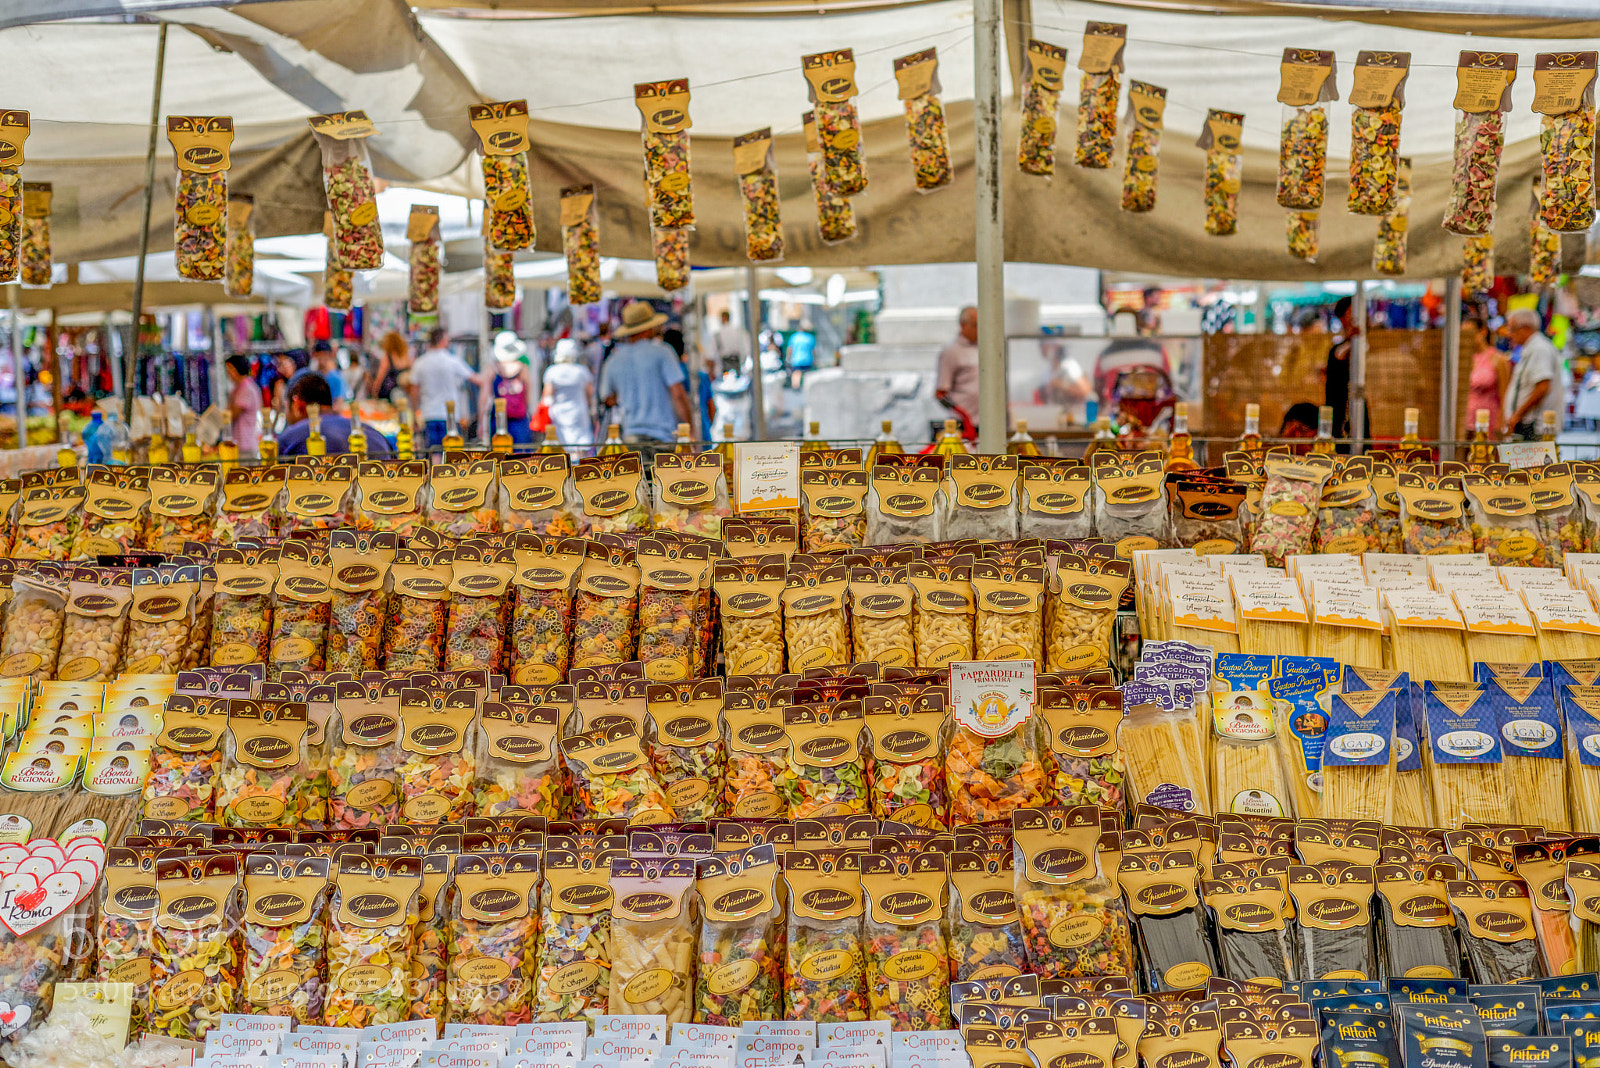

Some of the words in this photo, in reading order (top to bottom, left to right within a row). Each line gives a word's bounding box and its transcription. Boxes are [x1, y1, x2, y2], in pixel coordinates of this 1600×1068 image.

[1512, 445, 1544, 456] Campo
[672, 481, 707, 496] Spizzichino
[960, 670, 1025, 681] PAPPARDELLE
[353, 719, 393, 735] Spizzichino
[417, 727, 456, 744] Spizzichino
[671, 721, 709, 737] Spizzichino
[744, 726, 783, 743] Spizzichino
[1505, 728, 1554, 738] LAGANO
[887, 733, 928, 750] Spizzichino
[1065, 728, 1107, 746] Spizzichino
[1334, 740, 1383, 749] LAGANO
[1441, 738, 1491, 747] LAGANO
[249, 739, 289, 757] Spizzichino
[807, 740, 848, 758] Spizzichino
[10, 775, 60, 785] REGIONALI
[18, 767, 54, 778] Bontà
[92, 775, 139, 786] REGIONALI
[99, 767, 133, 779] Bontà
[1038, 851, 1084, 873] Spizzichino
[475, 890, 520, 909] Spizzichino
[565, 886, 611, 904] Spizzichino
[719, 891, 763, 912] Spizzichino
[806, 890, 853, 910] Spizzichino
[884, 893, 932, 914] Spizzichino
[1142, 885, 1186, 905] Spizzichino
[9, 904, 52, 920] Roma
[172, 895, 218, 917] Spizzichino
[255, 896, 304, 914] Spizzichino
[352, 896, 399, 916] Spizzichino
[626, 894, 672, 914] Spizzichino
[1312, 902, 1358, 920] Spizzichino
[1405, 899, 1449, 917] Spizzichino
[1231, 904, 1274, 922] Spizzichino
[1481, 914, 1524, 931] Spizzichino
[235, 1018, 276, 1032] Campo
[609, 1018, 651, 1035] Campo
[221, 1034, 263, 1050] Campo
[380, 1027, 421, 1042] Campo
[687, 1027, 729, 1045] Campo
[834, 1026, 876, 1042] Campo
[908, 1034, 950, 1050] Campo
[300, 1037, 341, 1054] Campo
[375, 1045, 417, 1060] Campo
[525, 1039, 567, 1056] Campo
[602, 1042, 644, 1058] Campo
[753, 1038, 796, 1055] Campo
[437, 1053, 481, 1068] Campo
